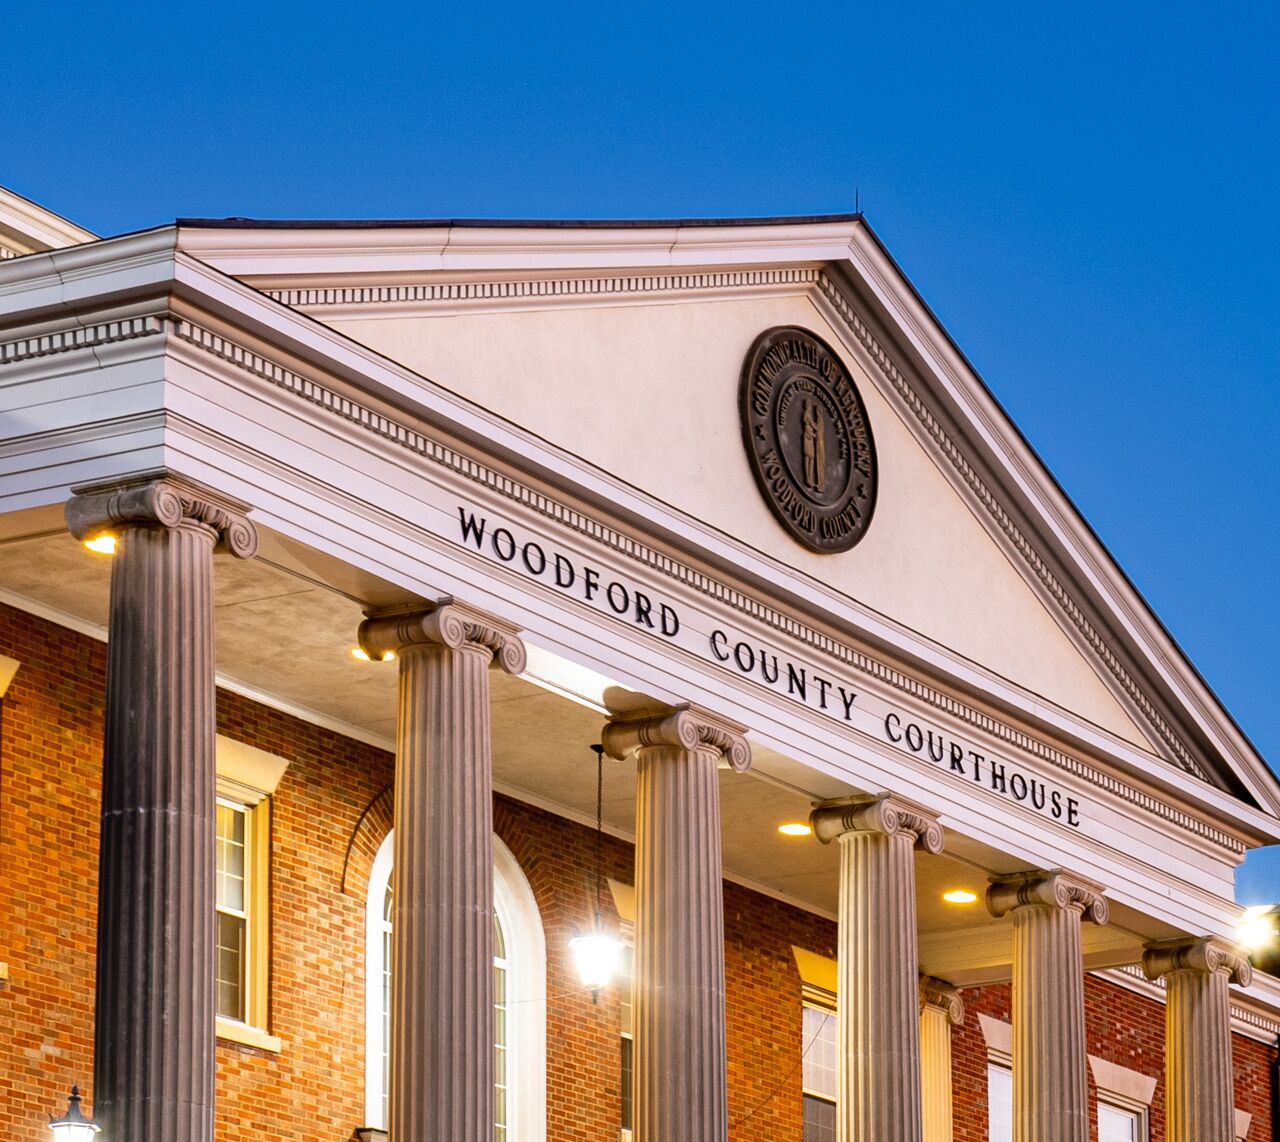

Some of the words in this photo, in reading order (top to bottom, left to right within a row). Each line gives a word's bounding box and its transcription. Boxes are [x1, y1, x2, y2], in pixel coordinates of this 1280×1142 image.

[754, 339, 820, 418] COMMONWEALTH
[822, 356, 838, 383] OF
[836, 373, 872, 479] KENTUCKY
[761, 448, 818, 534] WOODFORD
[822, 497, 864, 541] COUNTY
[457, 506, 681, 639] WOODFORD
[709, 629, 858, 722] COUNTY
[884, 711, 1082, 828] COURTHOUSE
